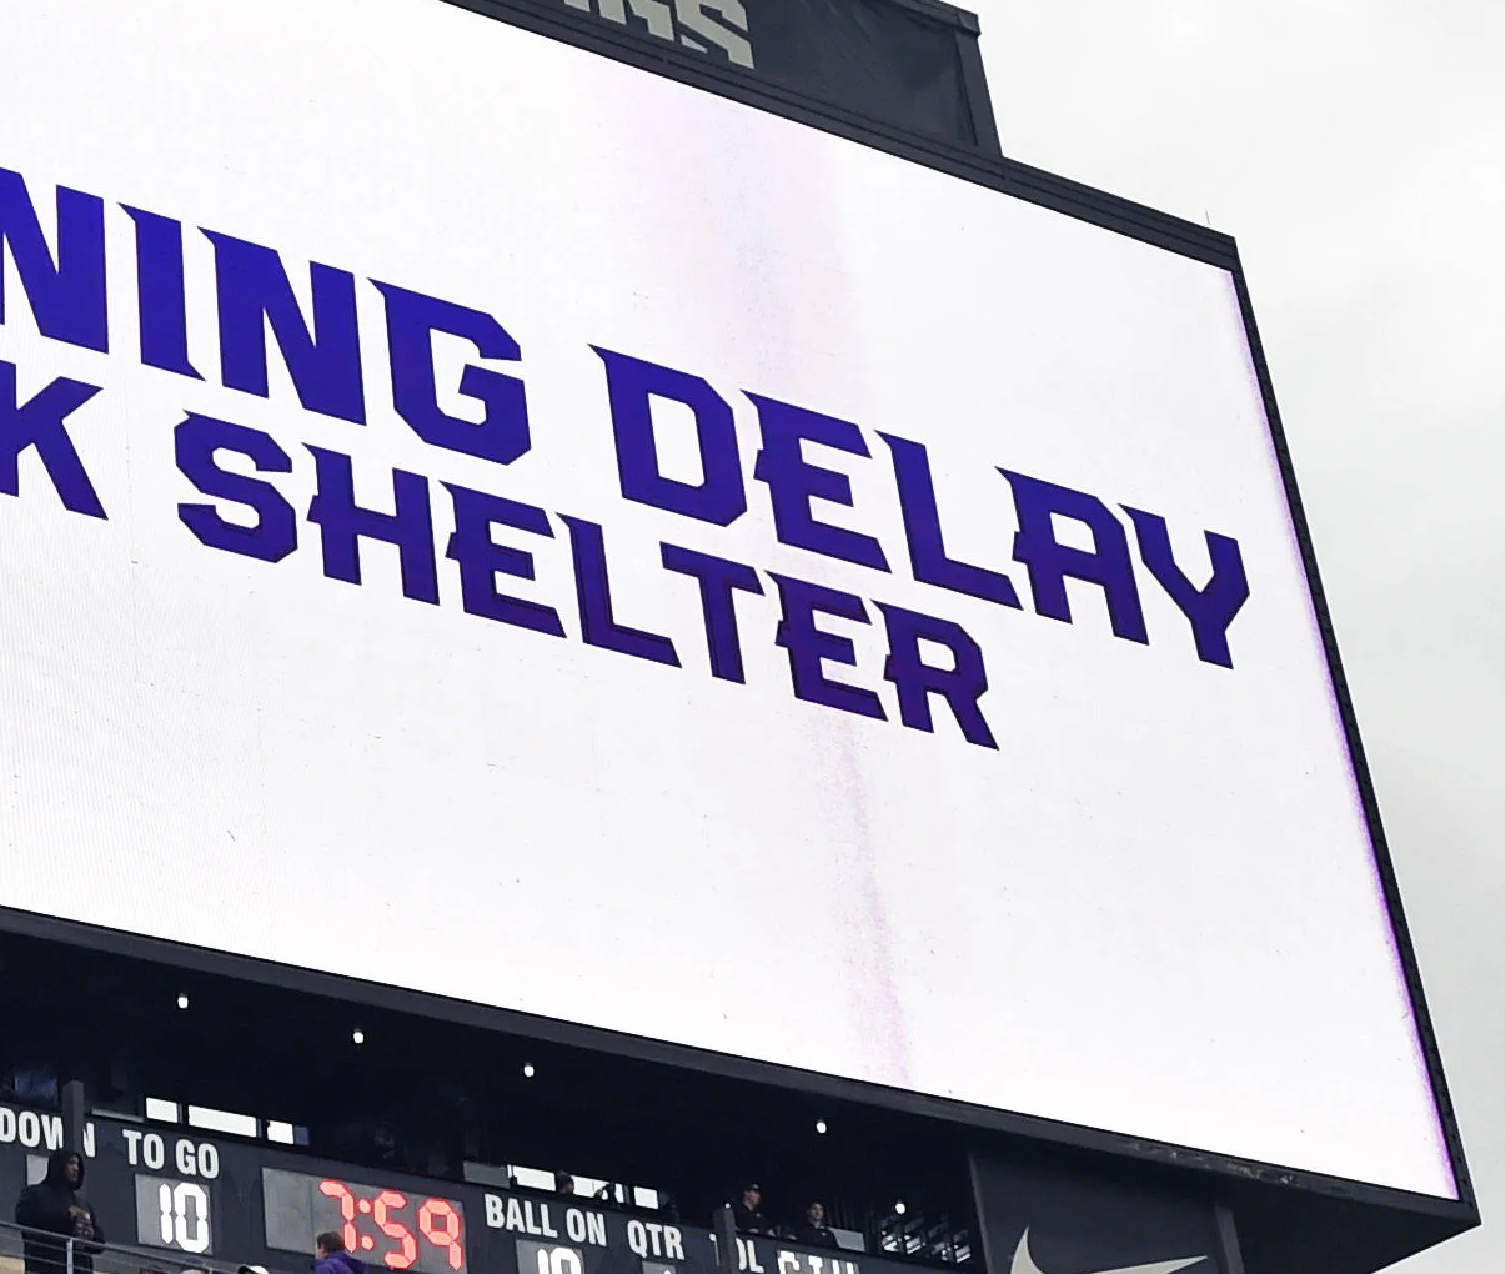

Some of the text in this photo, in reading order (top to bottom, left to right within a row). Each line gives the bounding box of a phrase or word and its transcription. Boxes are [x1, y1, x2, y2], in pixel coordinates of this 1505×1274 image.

[596, 347, 1246, 663] DELAY
[175, 413, 989, 744] SHELTER
[122, 1128, 219, 1179] TO GO
[160, 1183, 209, 1253] 10
[318, 1179, 463, 1271] 7:59
[485, 1193, 607, 1246] BALL ON
[627, 1220, 684, 1260] QTR
